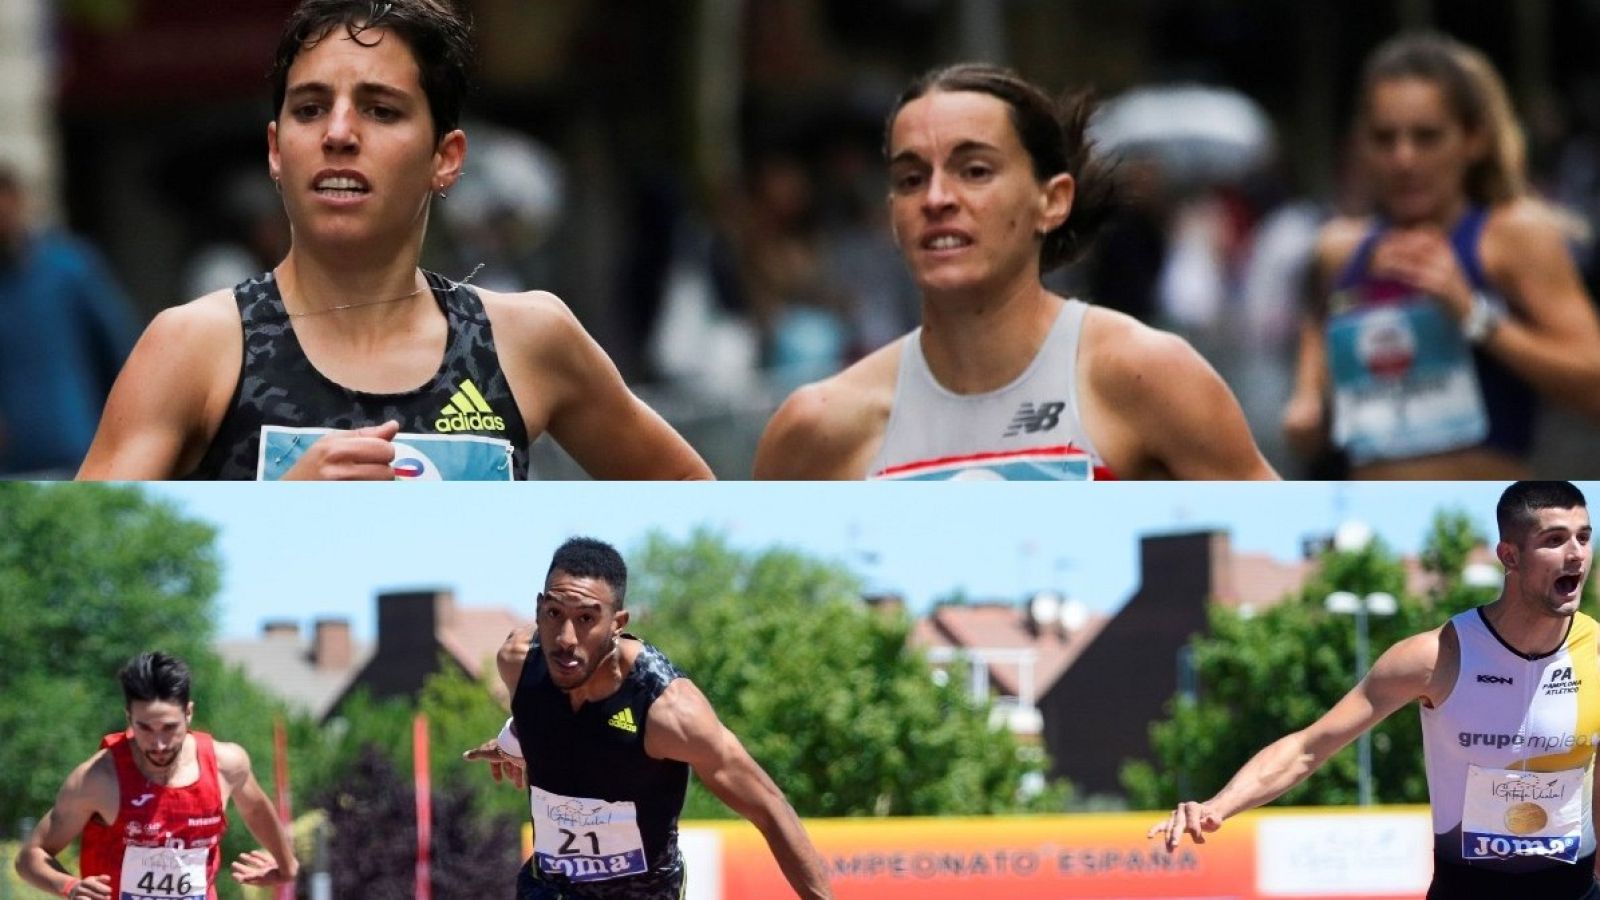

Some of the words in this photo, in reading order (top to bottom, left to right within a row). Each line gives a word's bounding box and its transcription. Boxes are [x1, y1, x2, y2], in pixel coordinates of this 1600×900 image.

[434, 412, 506, 432] adidas
[1551, 666, 1572, 682] PA
[1542, 679, 1582, 690] PAMPLONA
[608, 718, 637, 733] adidas
[558, 828, 601, 855] 21
[137, 871, 192, 896] 446
